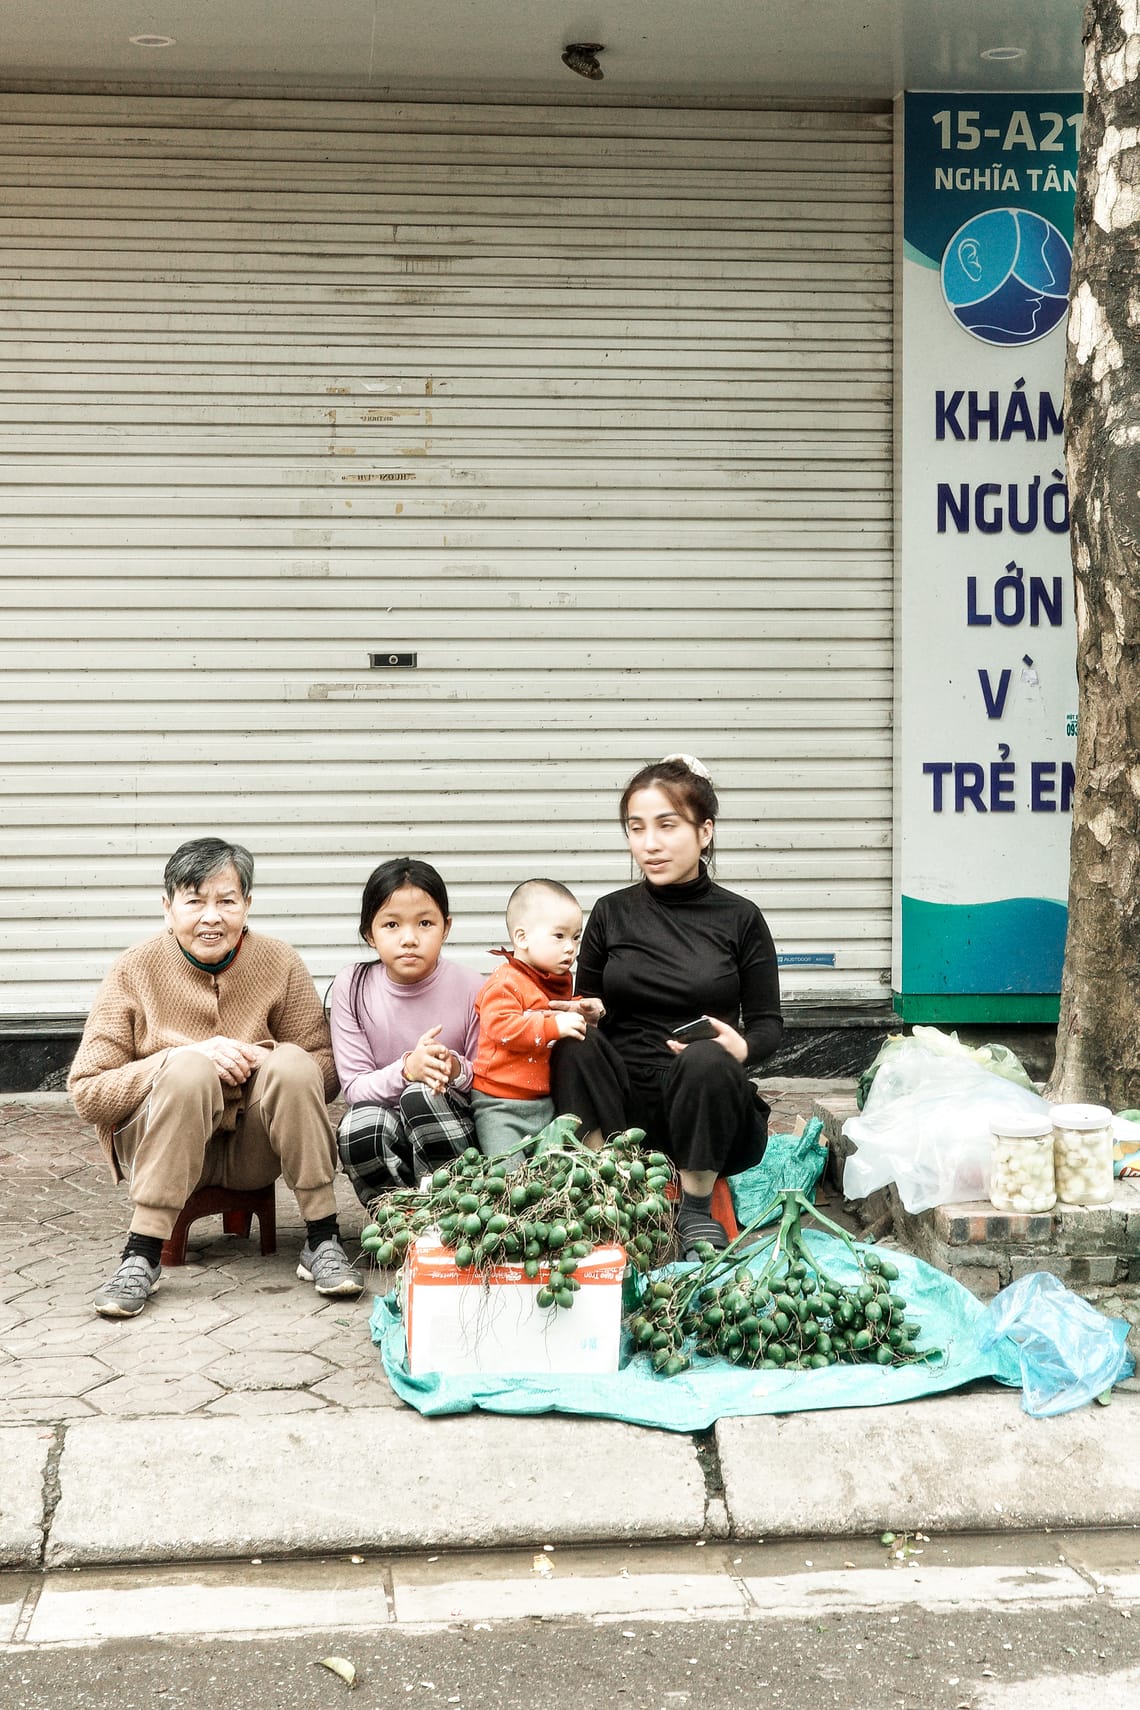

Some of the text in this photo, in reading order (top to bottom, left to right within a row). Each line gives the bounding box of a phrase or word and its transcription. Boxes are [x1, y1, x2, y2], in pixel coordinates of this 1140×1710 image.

[934, 162, 1078, 192] NGHĨA TÂN
[967, 560, 1062, 626] LỚN
[922, 743, 1016, 812] TRẺ
